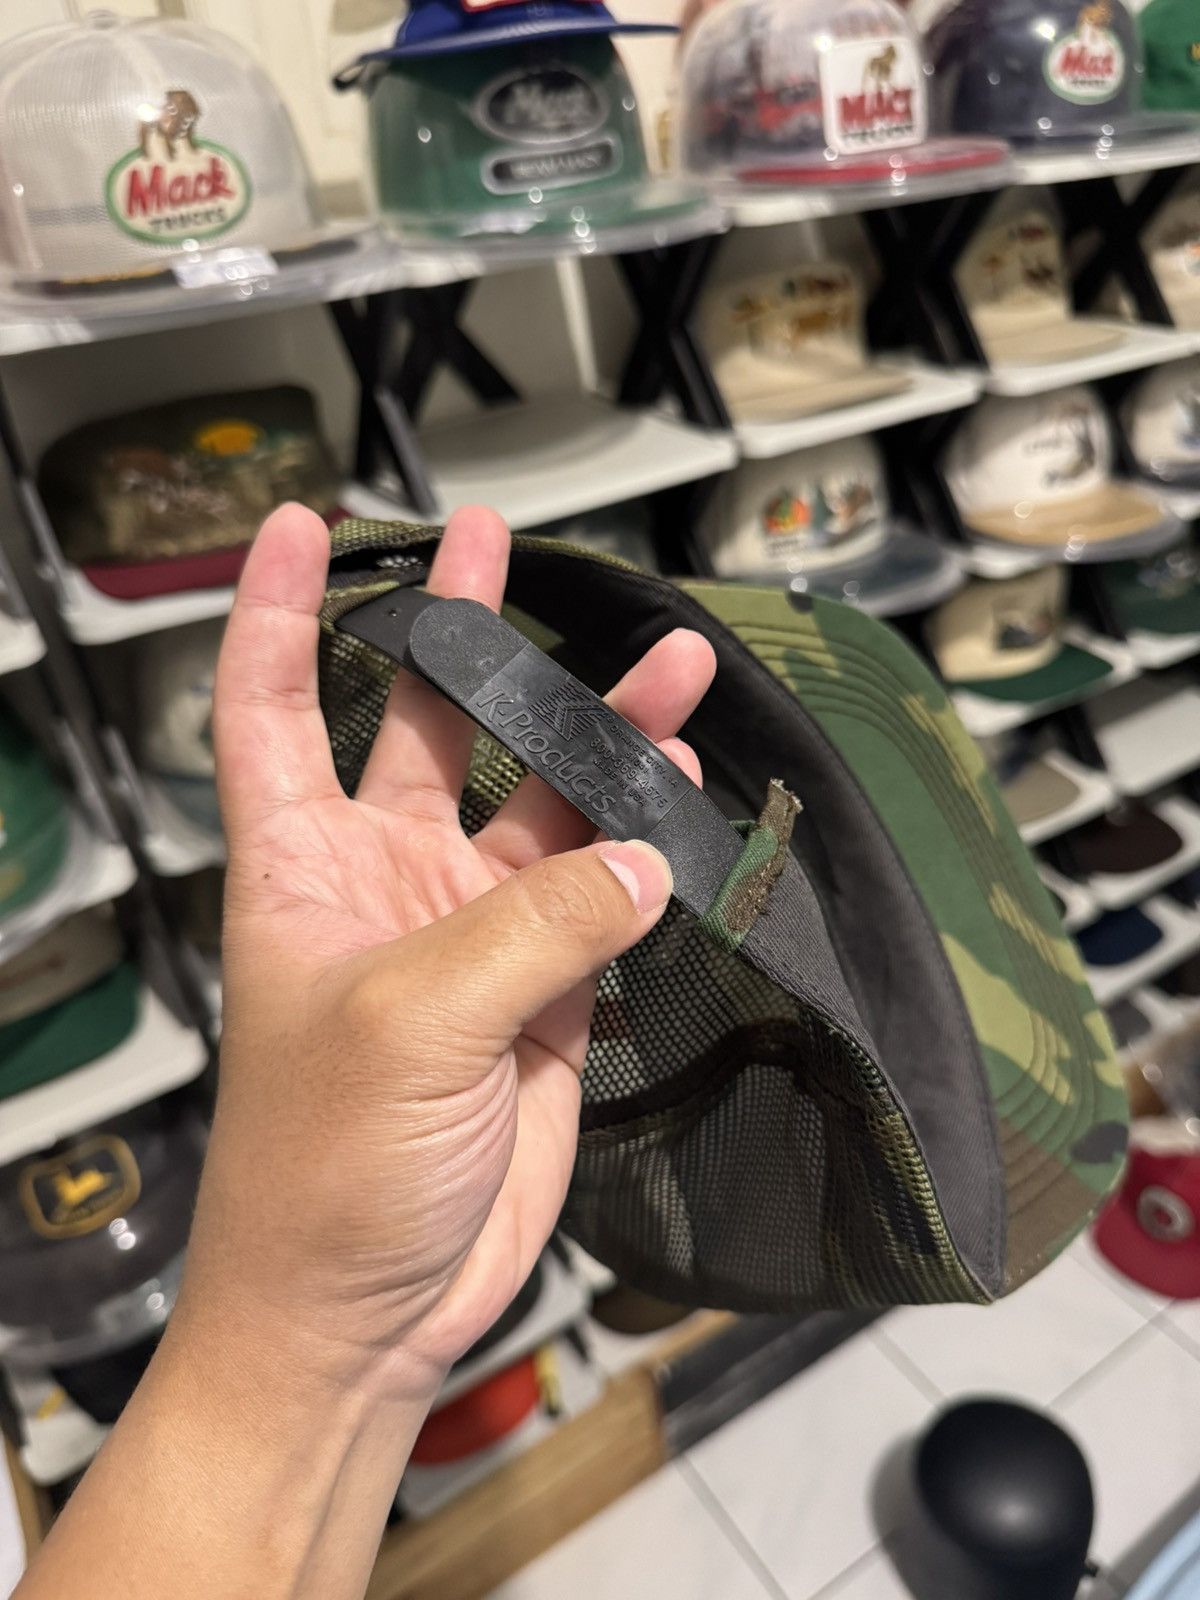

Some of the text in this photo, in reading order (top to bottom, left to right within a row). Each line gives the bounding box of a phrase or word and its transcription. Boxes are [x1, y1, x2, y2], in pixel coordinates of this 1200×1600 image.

[126, 154, 236, 218] Mack
[476, 690, 617, 813] K-Products
[610, 724, 646, 757] ORANGE
[627, 788, 647, 808] USA
